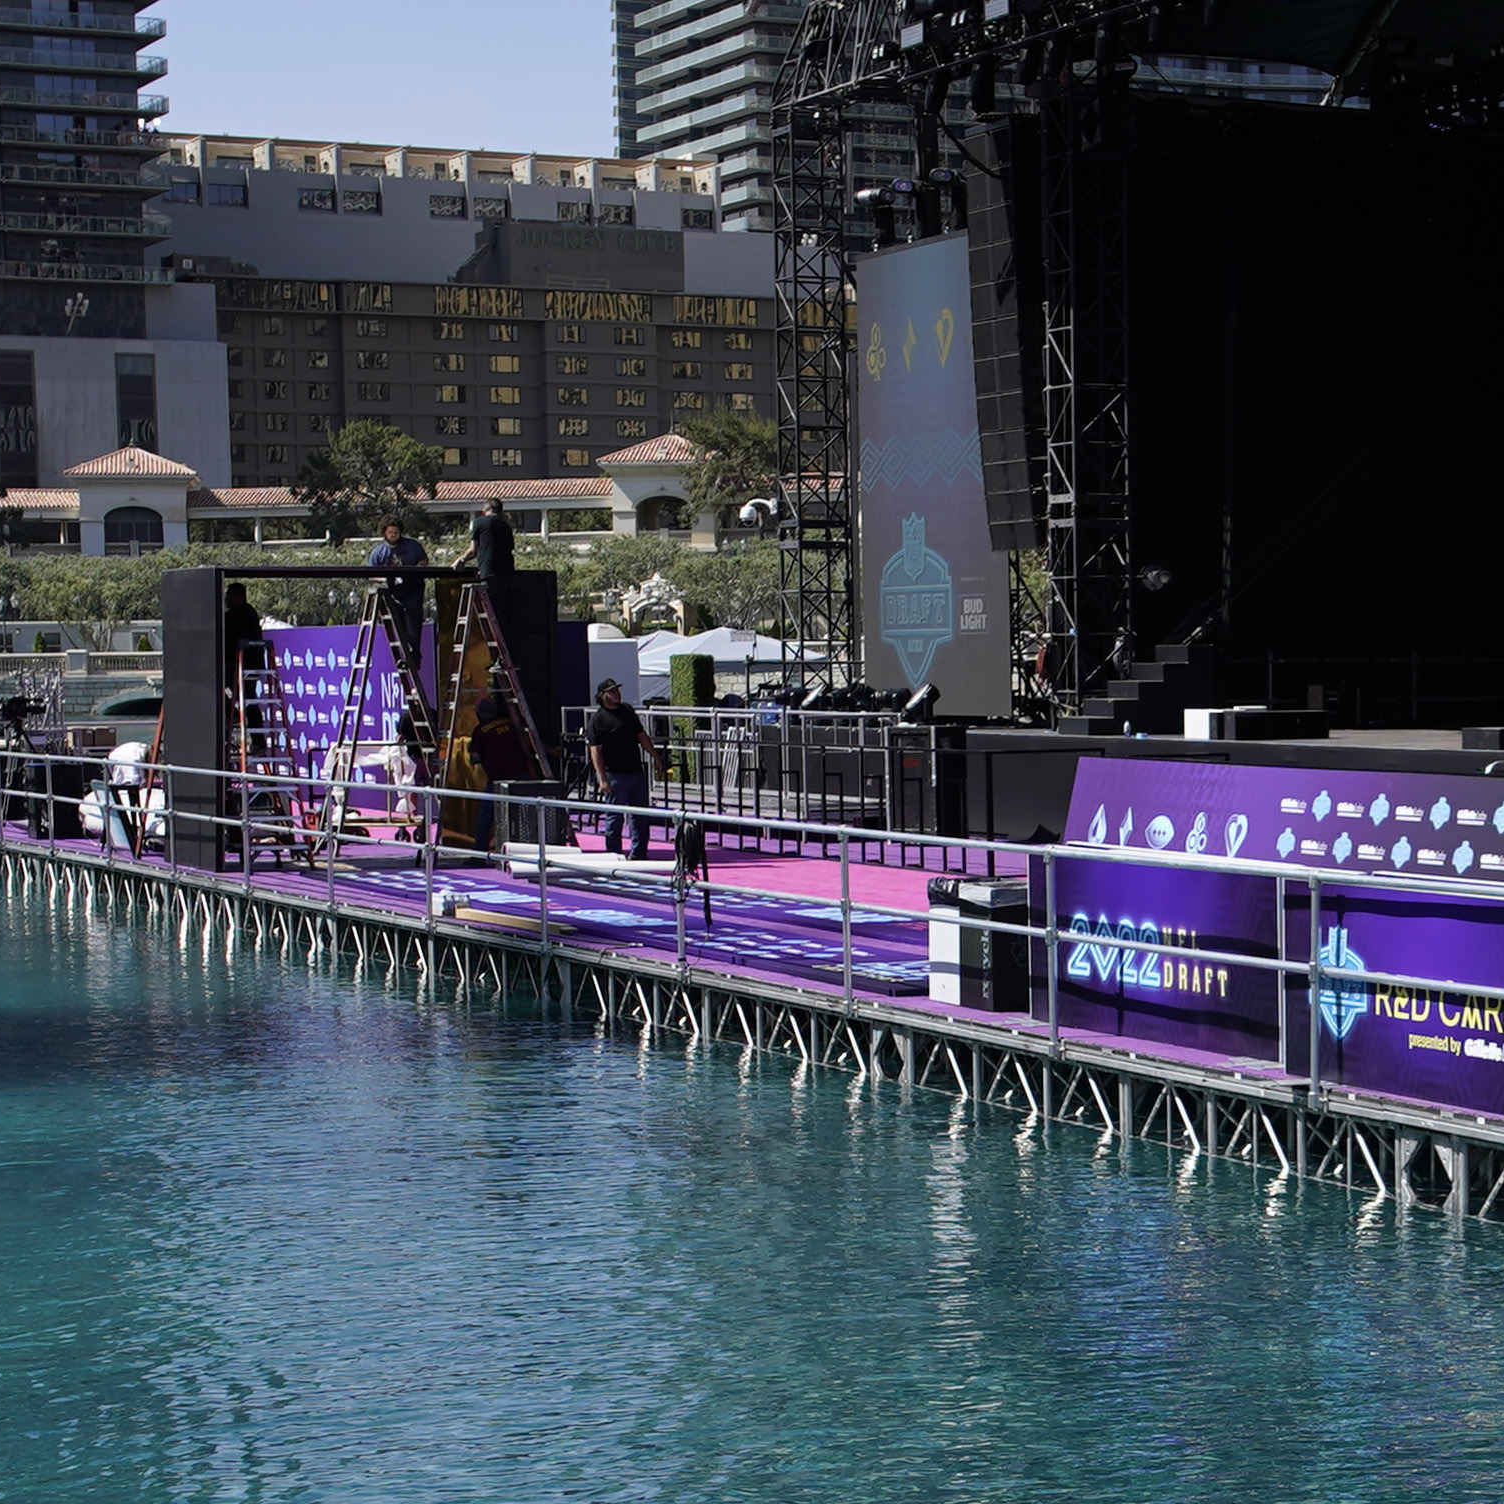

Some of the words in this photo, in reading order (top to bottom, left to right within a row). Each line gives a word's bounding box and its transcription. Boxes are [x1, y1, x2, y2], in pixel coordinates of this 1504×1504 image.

[516, 227, 610, 249] JOCKEY
[618, 230, 676, 254] CLUB
[885, 592, 947, 625] DRAFT
[963, 598, 984, 614] BUD
[960, 614, 988, 631] LIGHT
[1162, 960, 1229, 997] DRAFT
[1408, 1033, 1448, 1051] presented
[1450, 1038, 1462, 1056] by
